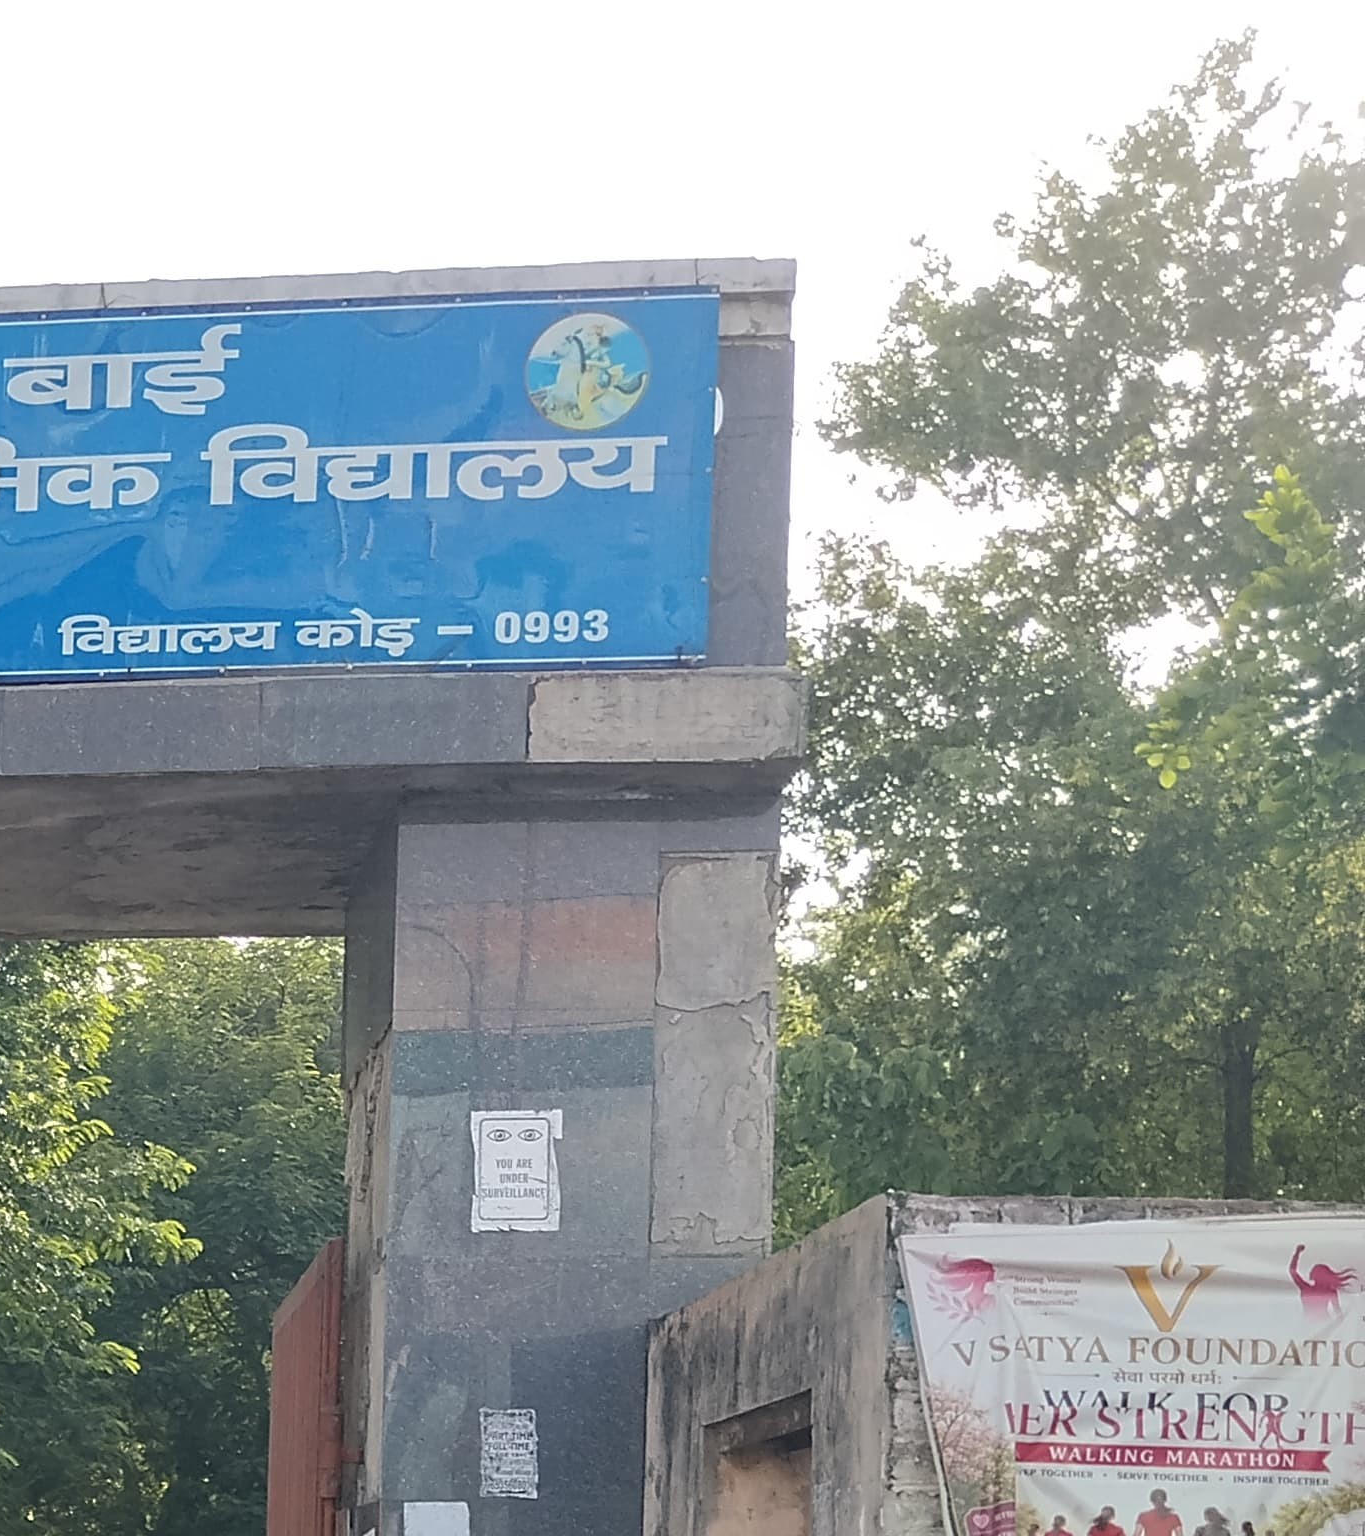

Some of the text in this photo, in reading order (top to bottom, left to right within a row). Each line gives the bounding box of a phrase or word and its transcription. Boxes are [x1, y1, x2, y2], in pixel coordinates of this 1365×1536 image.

[4, 323, 244, 417] बाई
[203, 422, 667, 506] विद्यालय
[59, 617, 281, 658] विद्यालय
[494, 610, 609, 646] 0993
[495, 1158, 533, 1169] YOU ARE
[499, 1173, 529, 1184] UNDER
[481, 1187, 547, 1199] SURVEILLANCE
[951, 1341, 975, 1368] V
[990, 1335, 1111, 1364] SATYA
[1112, 1368, 1144, 1385] सेवा
[1049, 1444, 1297, 1469] WALKING MARATHON
[1153, 1471, 1209, 1482] TOGETHER
[1233, 1475, 1275, 1485] INSPIRE
[1277, 1476, 1330, 1486] TOGETHER
